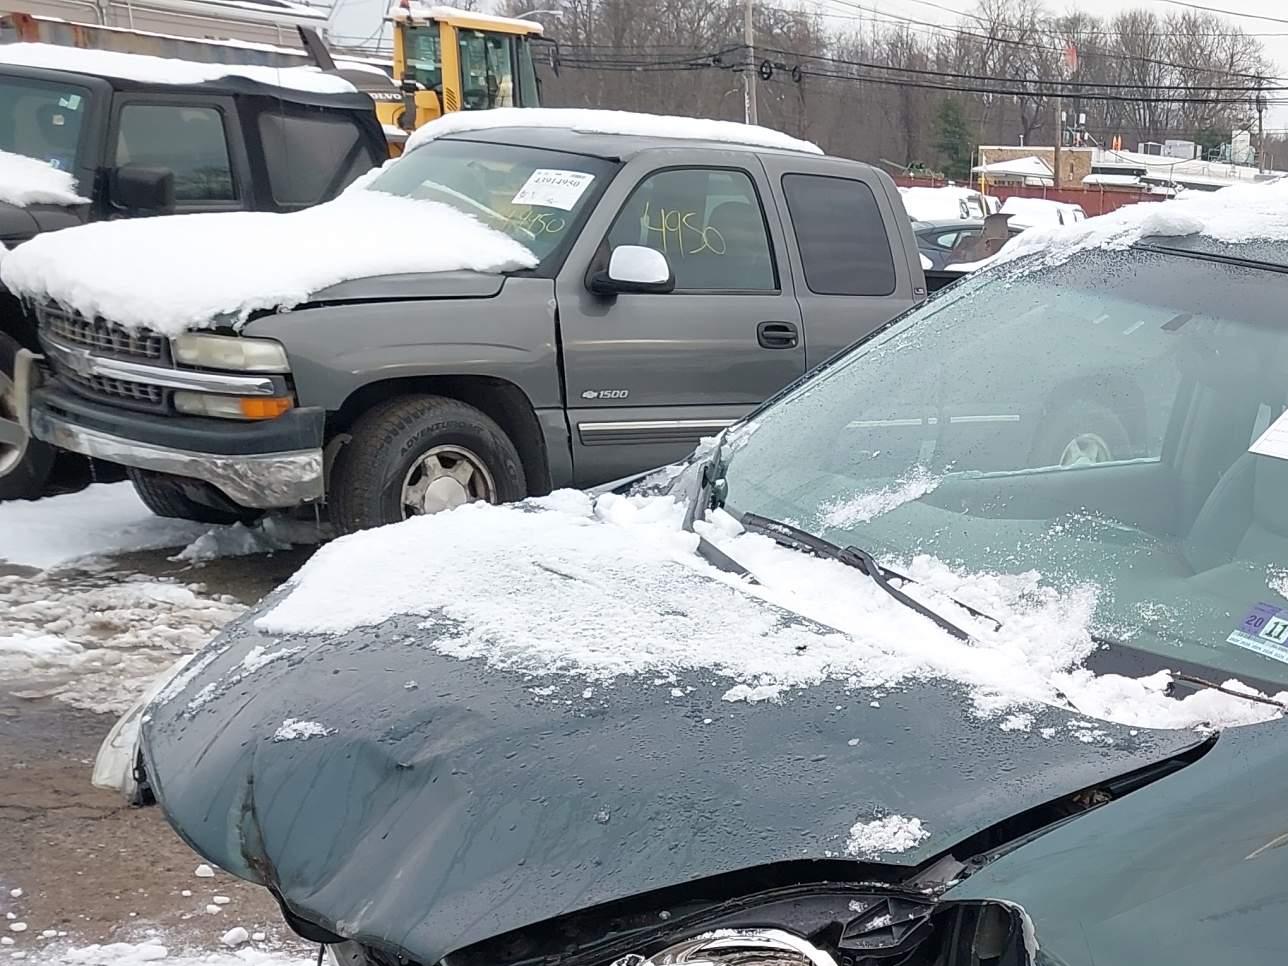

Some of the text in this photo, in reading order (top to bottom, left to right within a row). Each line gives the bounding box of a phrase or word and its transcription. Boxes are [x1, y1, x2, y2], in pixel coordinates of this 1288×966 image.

[640, 201, 727, 259] 4950
[599, 390, 629, 399] 1500
[1245, 615, 1265, 628] 20
[1264, 621, 1288, 639] 11
